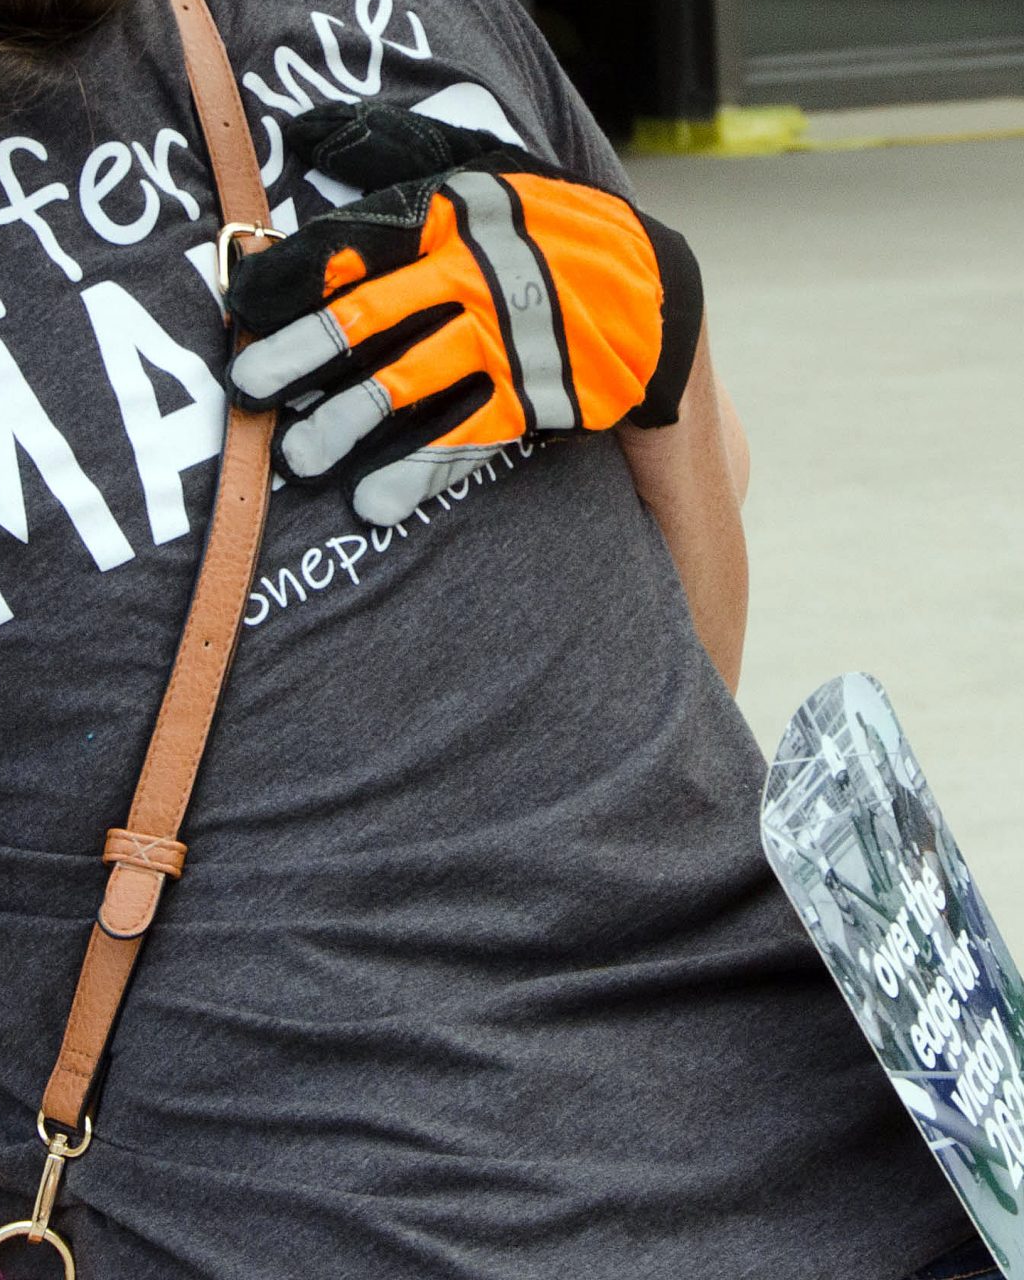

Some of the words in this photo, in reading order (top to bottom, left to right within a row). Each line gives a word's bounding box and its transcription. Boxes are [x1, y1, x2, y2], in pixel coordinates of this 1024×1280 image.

[931, 929, 980, 1003] for
[909, 974, 961, 1070] edge
[949, 1006, 1019, 1128] victory
